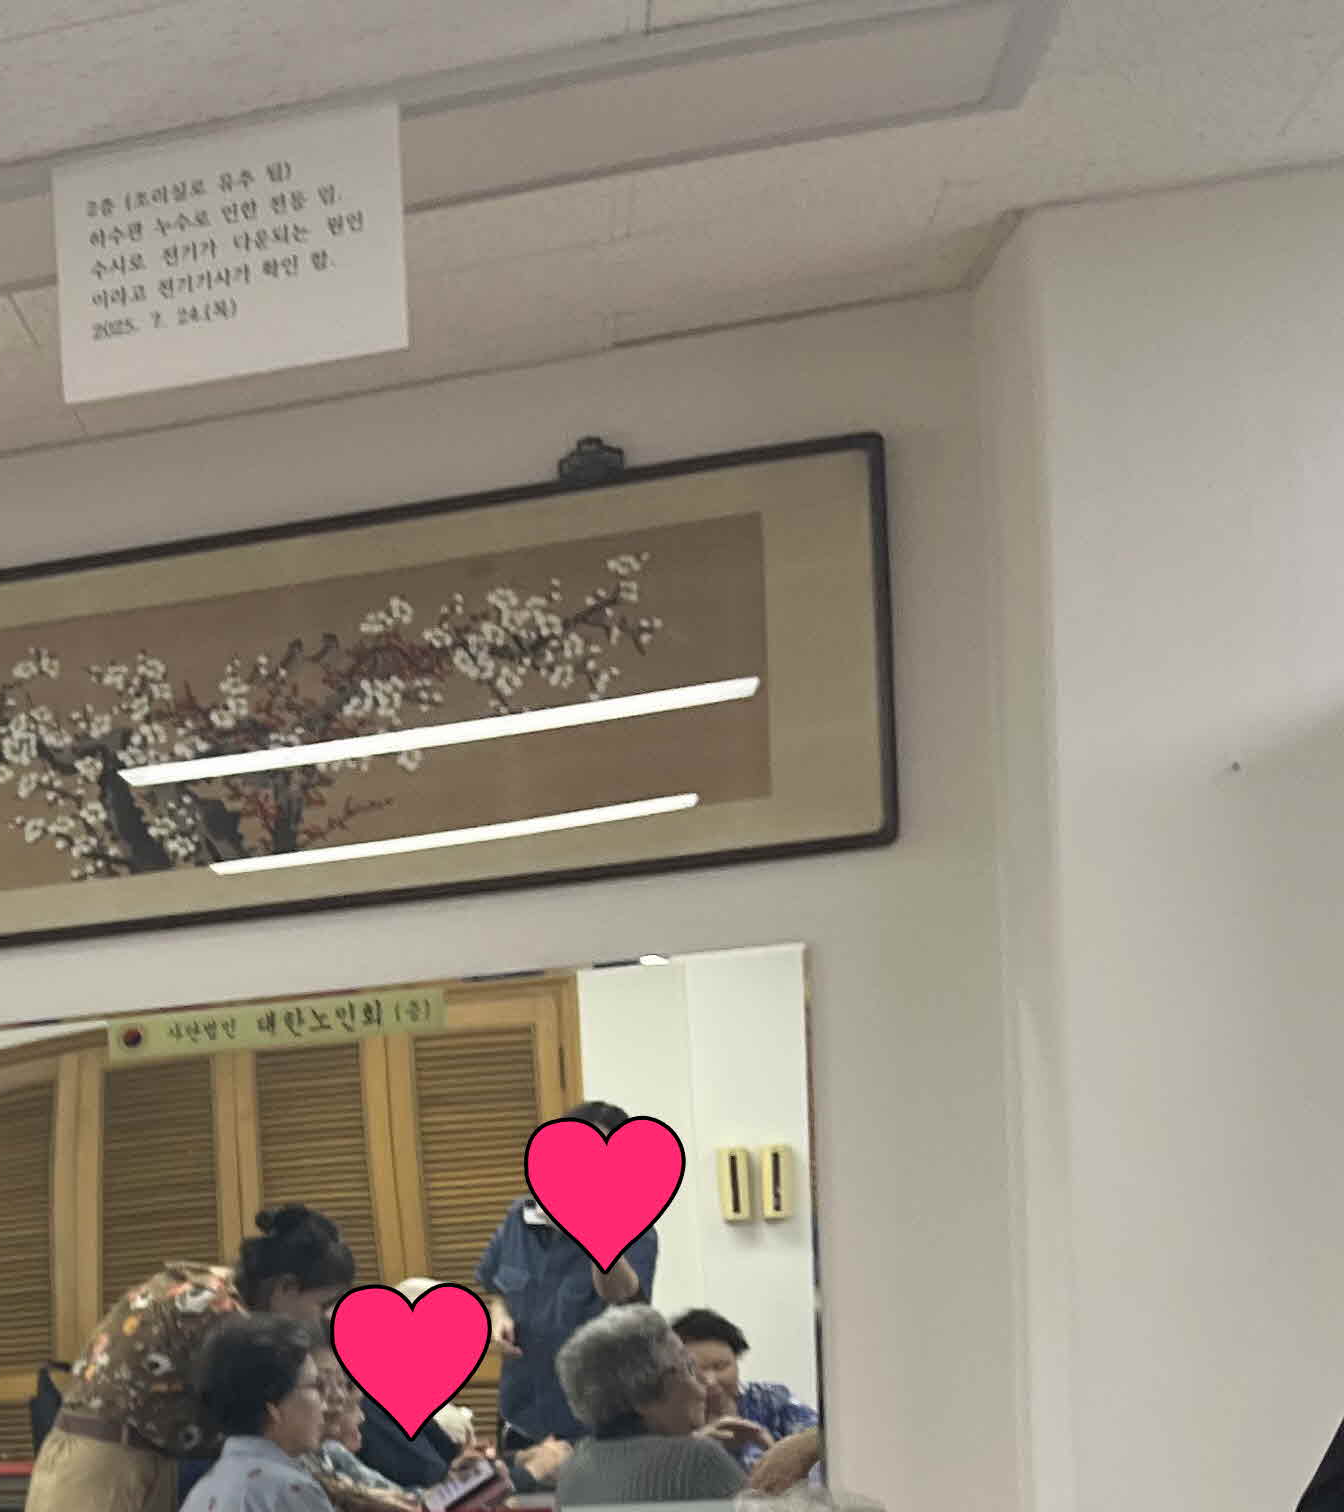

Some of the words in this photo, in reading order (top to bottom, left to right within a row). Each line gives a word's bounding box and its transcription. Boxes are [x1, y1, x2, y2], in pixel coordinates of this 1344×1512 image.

[153, 209, 212, 237] 누수로
[90, 252, 147, 280] 수시로
[162, 238, 218, 267] 전기가
[327, 209, 364, 237] 원인
[261, 254, 299, 278] 확인
[168, 1016, 237, 1043] 사단법인
[256, 998, 383, 1038] 대한노인회
